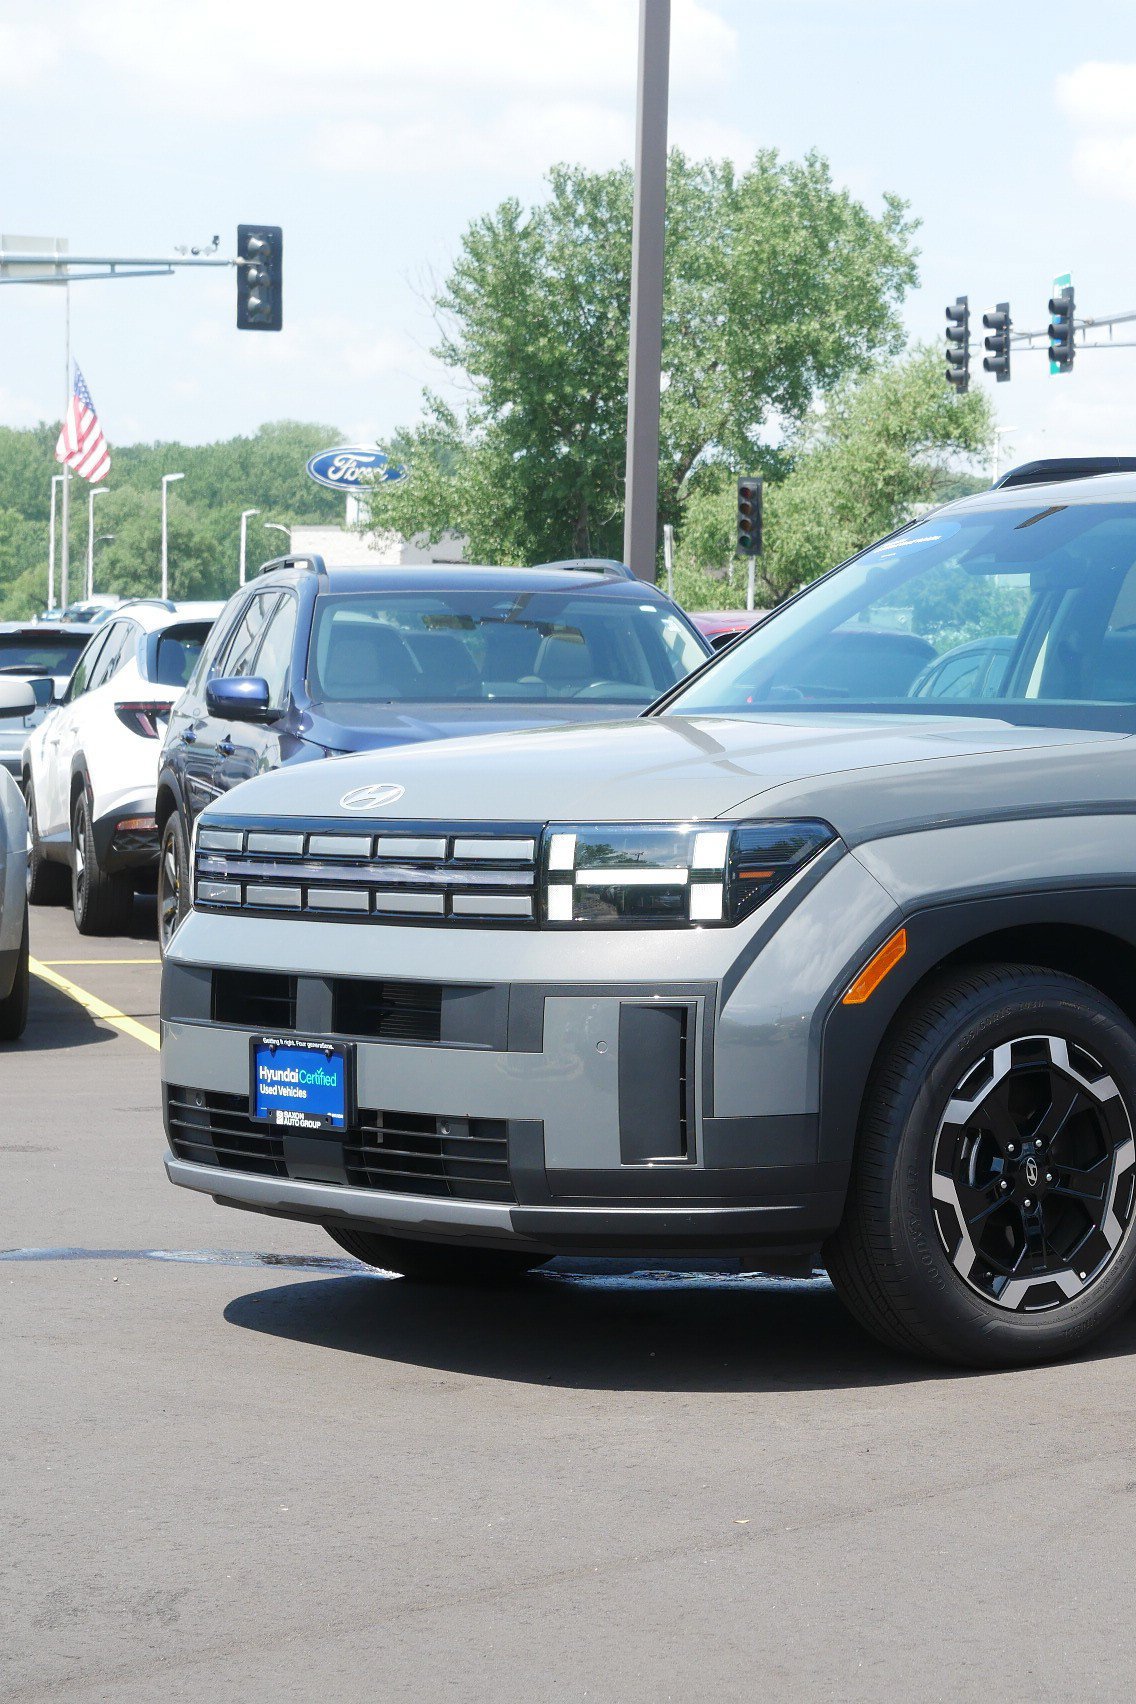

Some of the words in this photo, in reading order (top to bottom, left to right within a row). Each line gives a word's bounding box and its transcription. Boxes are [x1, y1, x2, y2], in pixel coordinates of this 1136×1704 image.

[327, 453, 389, 481] Ford
[259, 1065, 299, 1083] Hyundai
[299, 1067, 337, 1087] Certified
[260, 1083, 277, 1096] Used
[278, 1085, 307, 1099] Vehicles
[283, 1111, 305, 1120] SAXON
[283, 1117, 300, 1127] AUTO
[299, 1119, 322, 1129] GROUP
